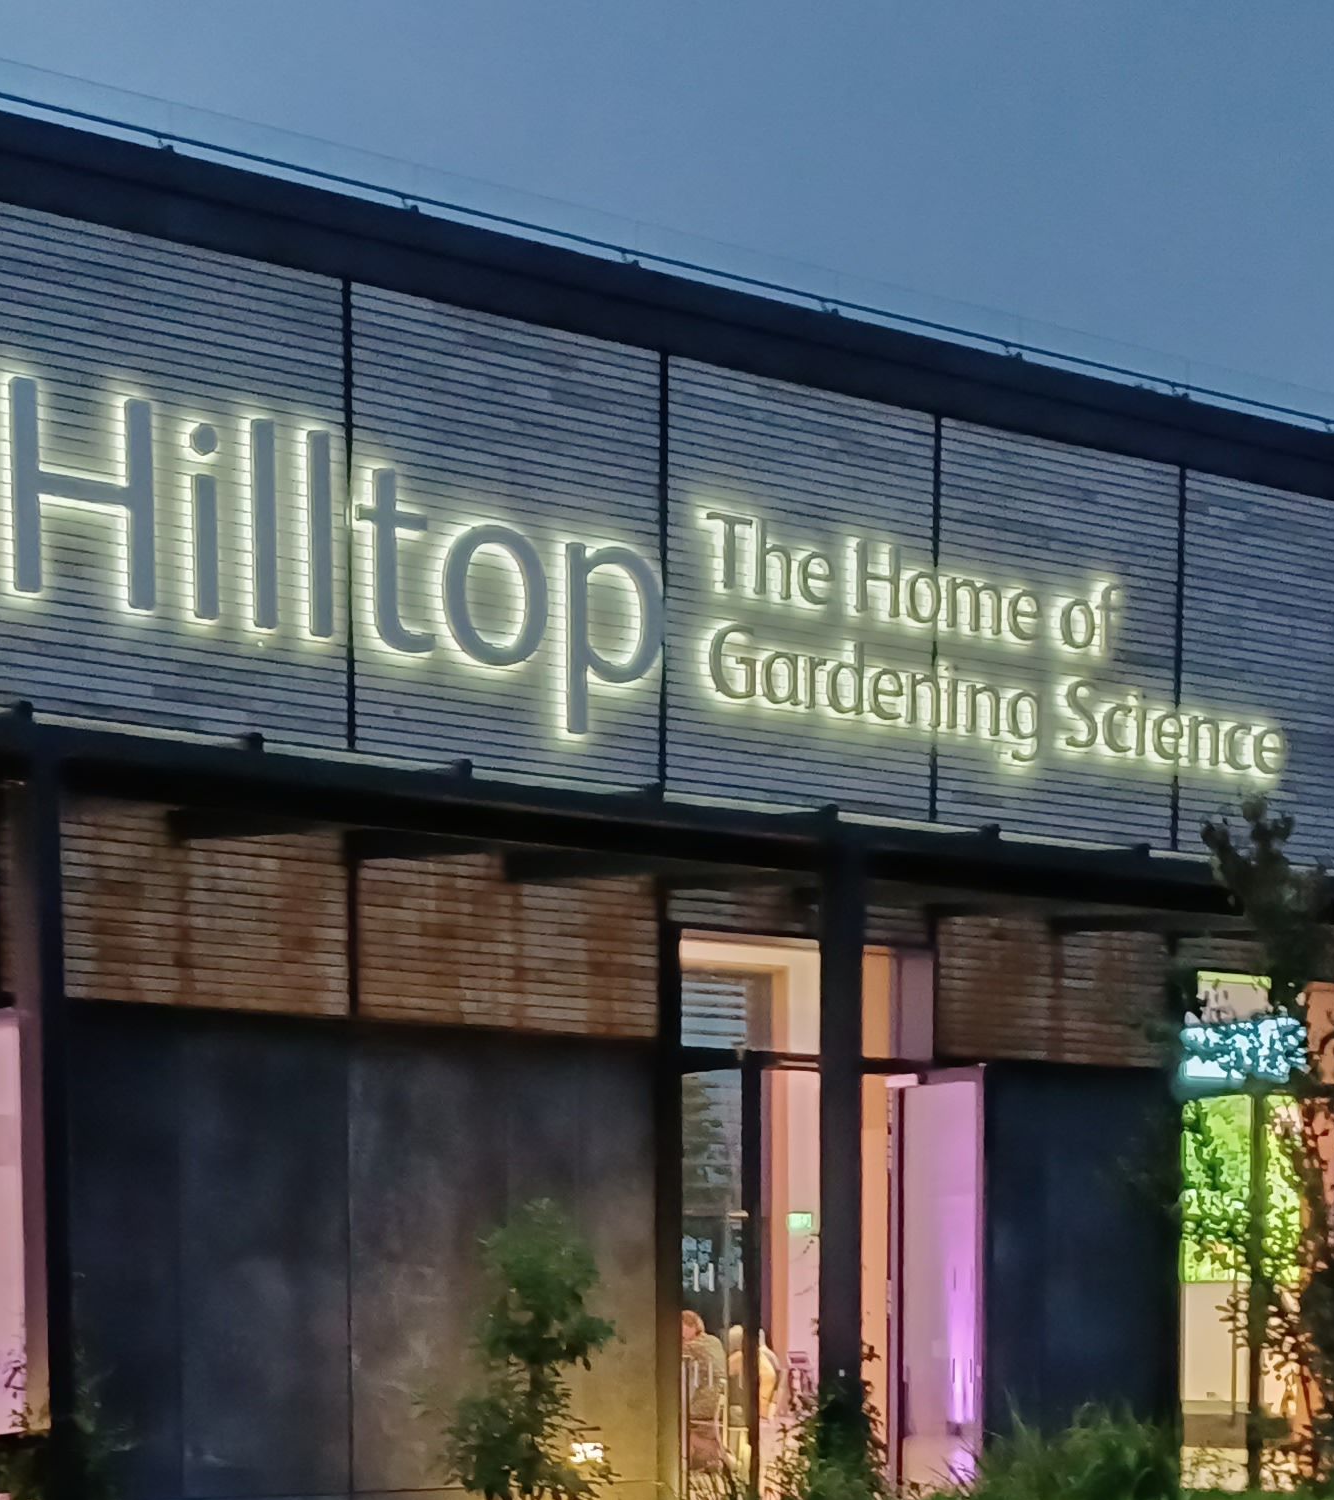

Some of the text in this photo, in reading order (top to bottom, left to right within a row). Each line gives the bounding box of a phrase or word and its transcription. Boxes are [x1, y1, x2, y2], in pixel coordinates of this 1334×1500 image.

[8, 376, 664, 735] Hilltop
[706, 511, 1122, 650] The Home of
[708, 623, 1288, 774] Gardening Science
